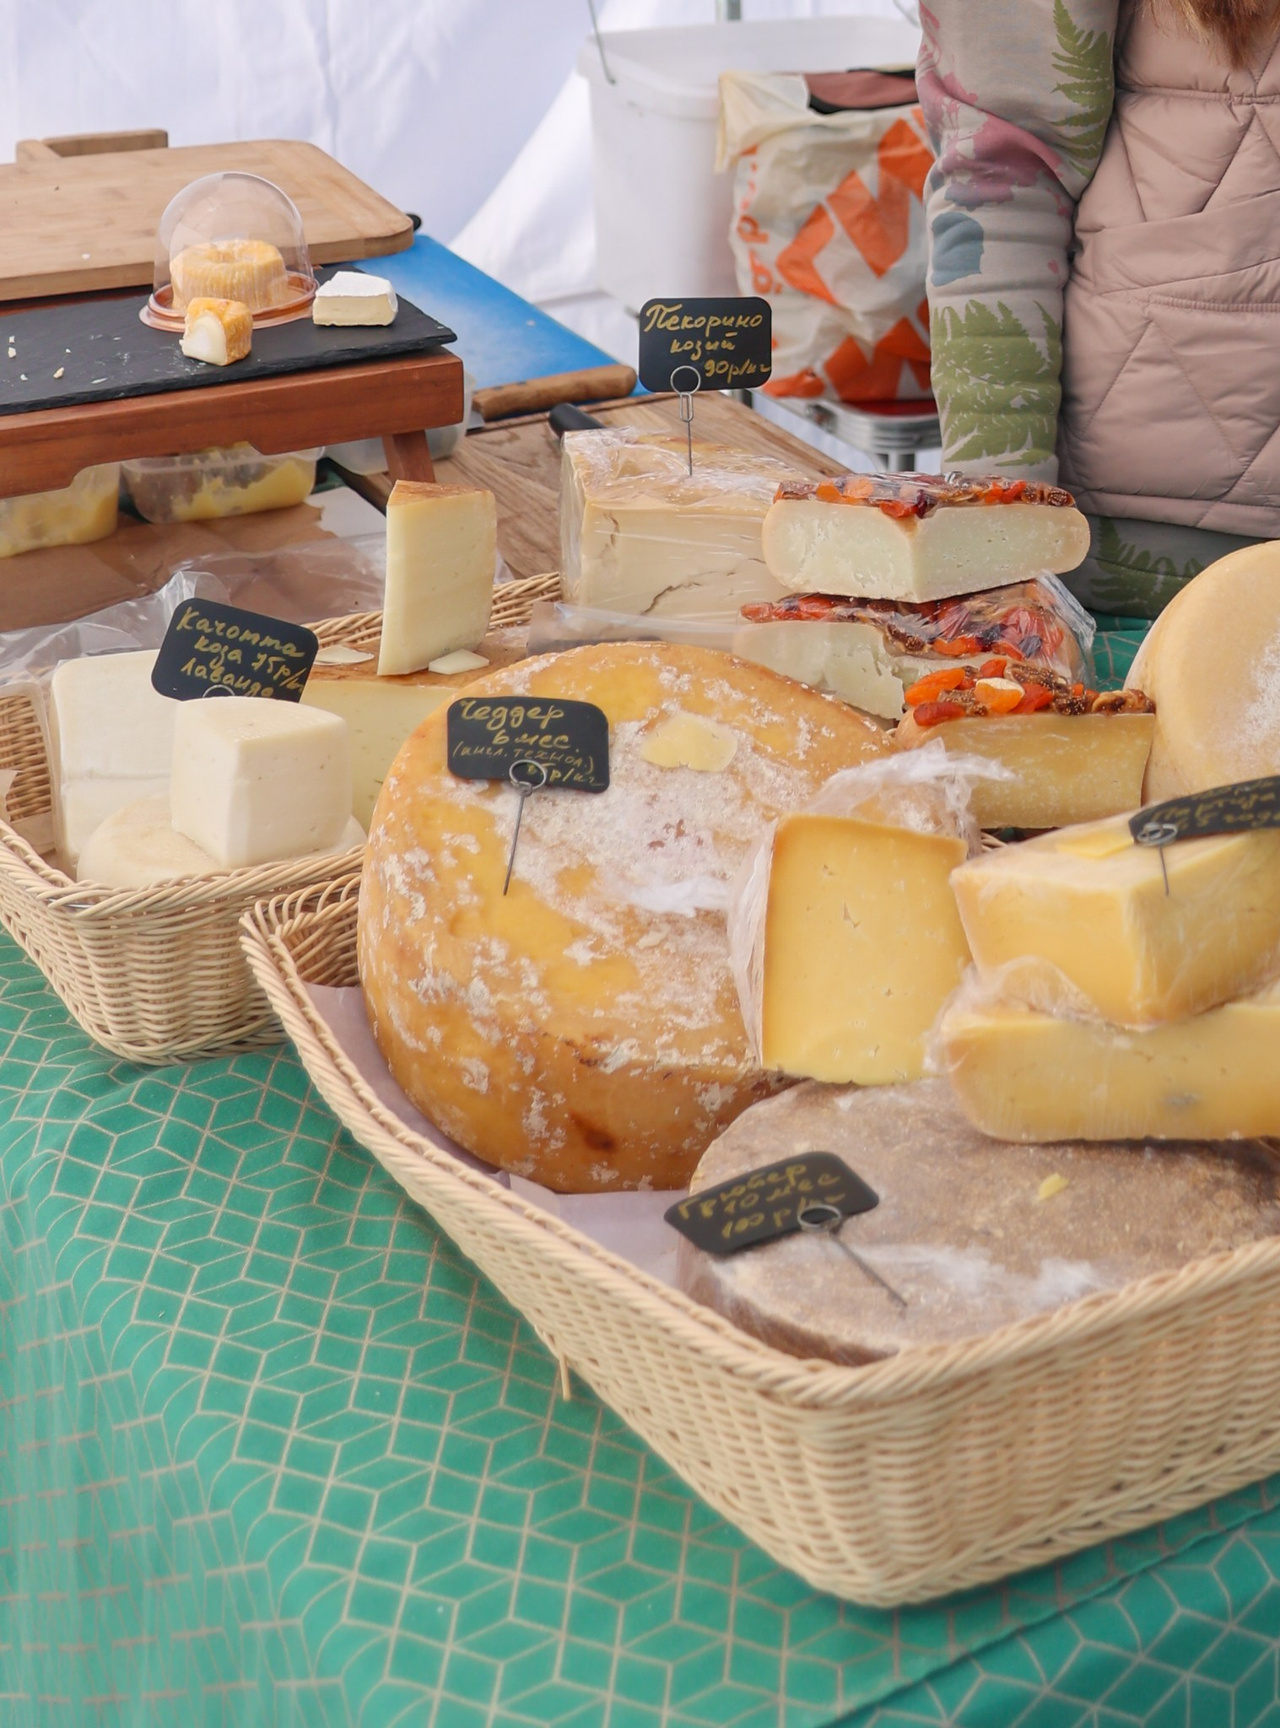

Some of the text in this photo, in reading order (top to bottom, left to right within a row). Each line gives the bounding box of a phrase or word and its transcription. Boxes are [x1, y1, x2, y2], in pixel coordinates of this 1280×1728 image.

[644, 304, 763, 337] Пекорино
[670, 332, 736, 361] козий
[194, 636, 242, 671] коза
[460, 700, 565, 730] Чеддер
